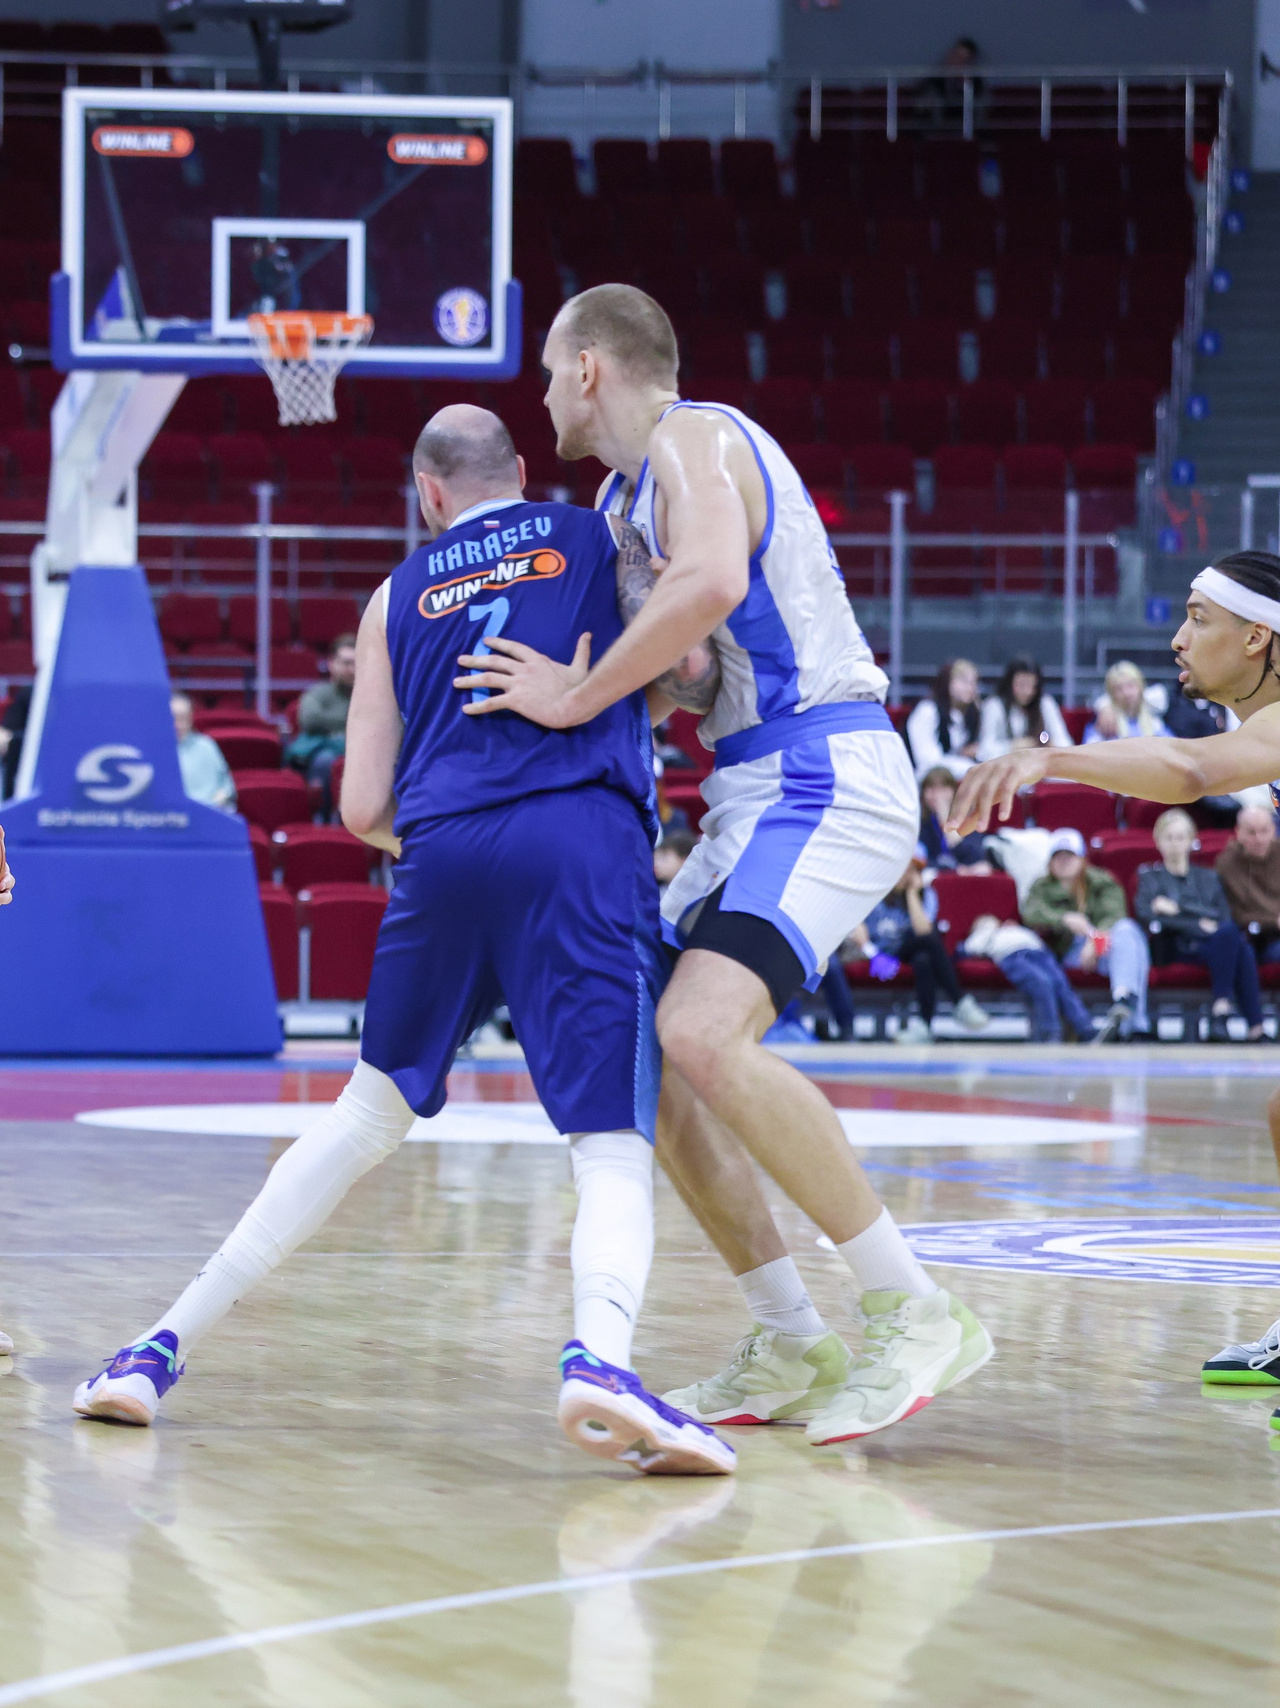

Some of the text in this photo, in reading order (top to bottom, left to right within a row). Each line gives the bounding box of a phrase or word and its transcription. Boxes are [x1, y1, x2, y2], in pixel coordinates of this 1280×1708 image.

[428, 516, 552, 576] KARASEV
[431, 559, 531, 611] WININE
[468, 596, 510, 704] 7
